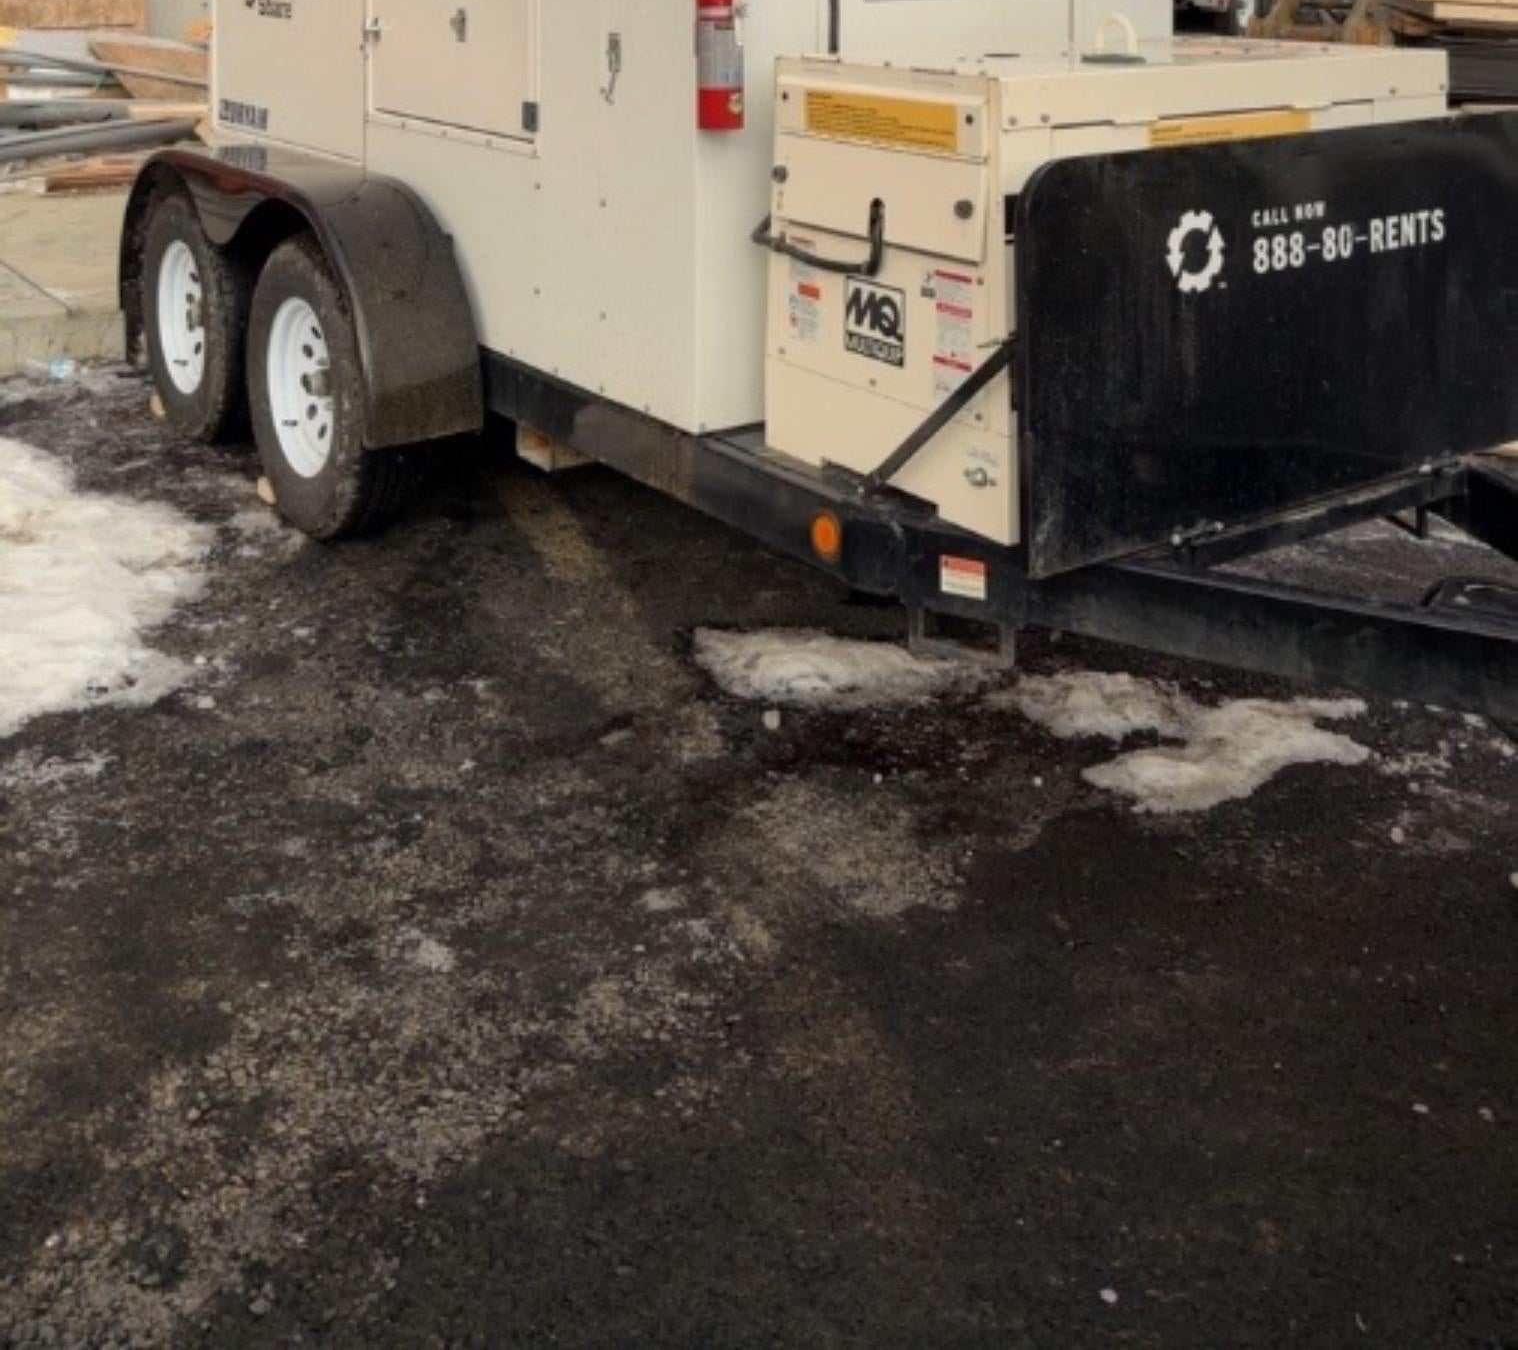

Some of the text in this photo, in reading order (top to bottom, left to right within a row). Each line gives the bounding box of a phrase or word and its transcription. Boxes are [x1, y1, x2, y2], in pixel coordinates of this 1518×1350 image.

[1252, 201, 1326, 228] CALL NOW
[1252, 207, 1446, 274] 888-80-RENTS
